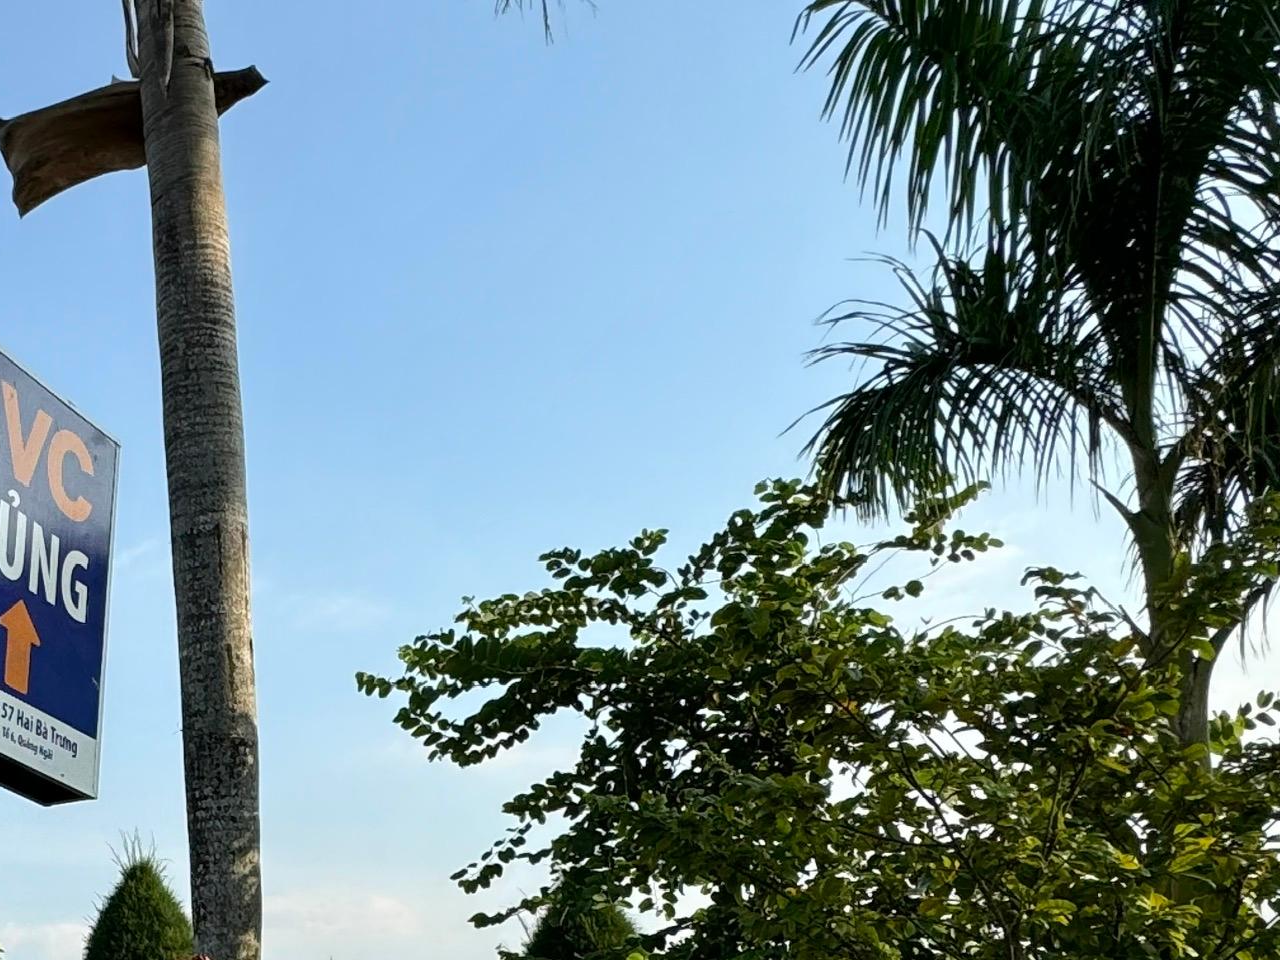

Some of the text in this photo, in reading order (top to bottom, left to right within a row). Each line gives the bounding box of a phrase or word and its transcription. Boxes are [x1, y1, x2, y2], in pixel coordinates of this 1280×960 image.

[1, 702, 15, 722] 57
[16, 709, 34, 733] Hai
[35, 718, 48, 741] Bà
[50, 726, 78, 758] Trưng
